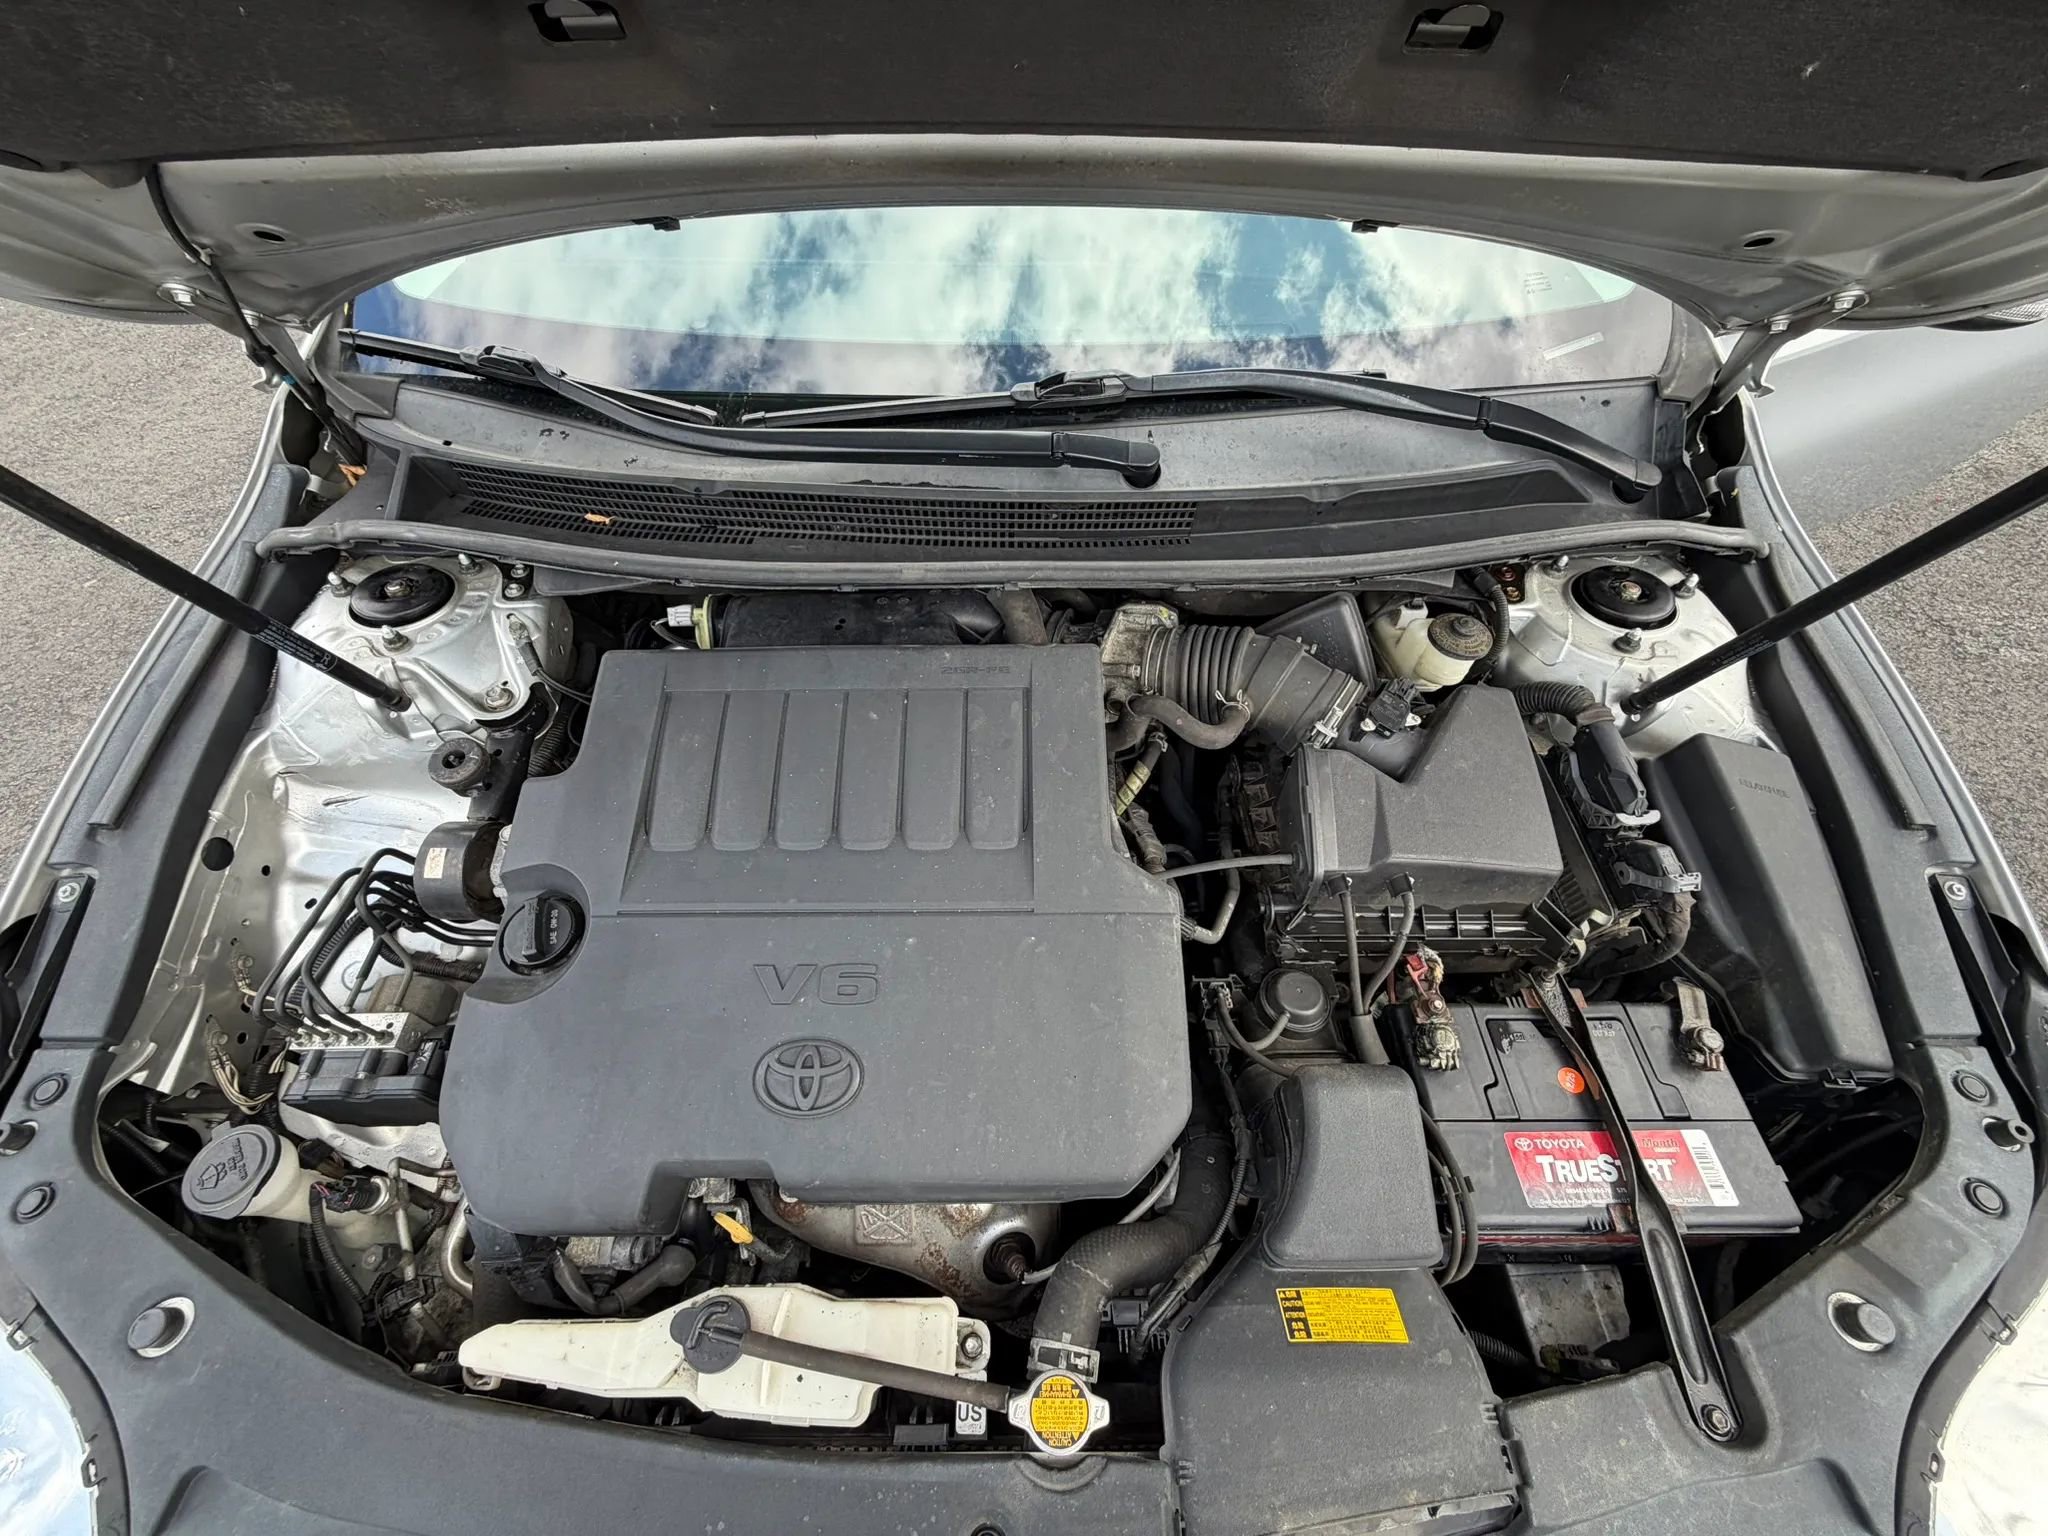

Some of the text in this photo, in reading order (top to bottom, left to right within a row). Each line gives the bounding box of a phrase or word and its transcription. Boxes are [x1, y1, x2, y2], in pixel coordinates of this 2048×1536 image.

[549, 930, 558, 945] SAE
[752, 963, 878, 1006] V6
[1533, 1139, 1586, 1149] TOYOTA
[1641, 1138, 1679, 1149] Month
[957, 1403, 982, 1422] US
